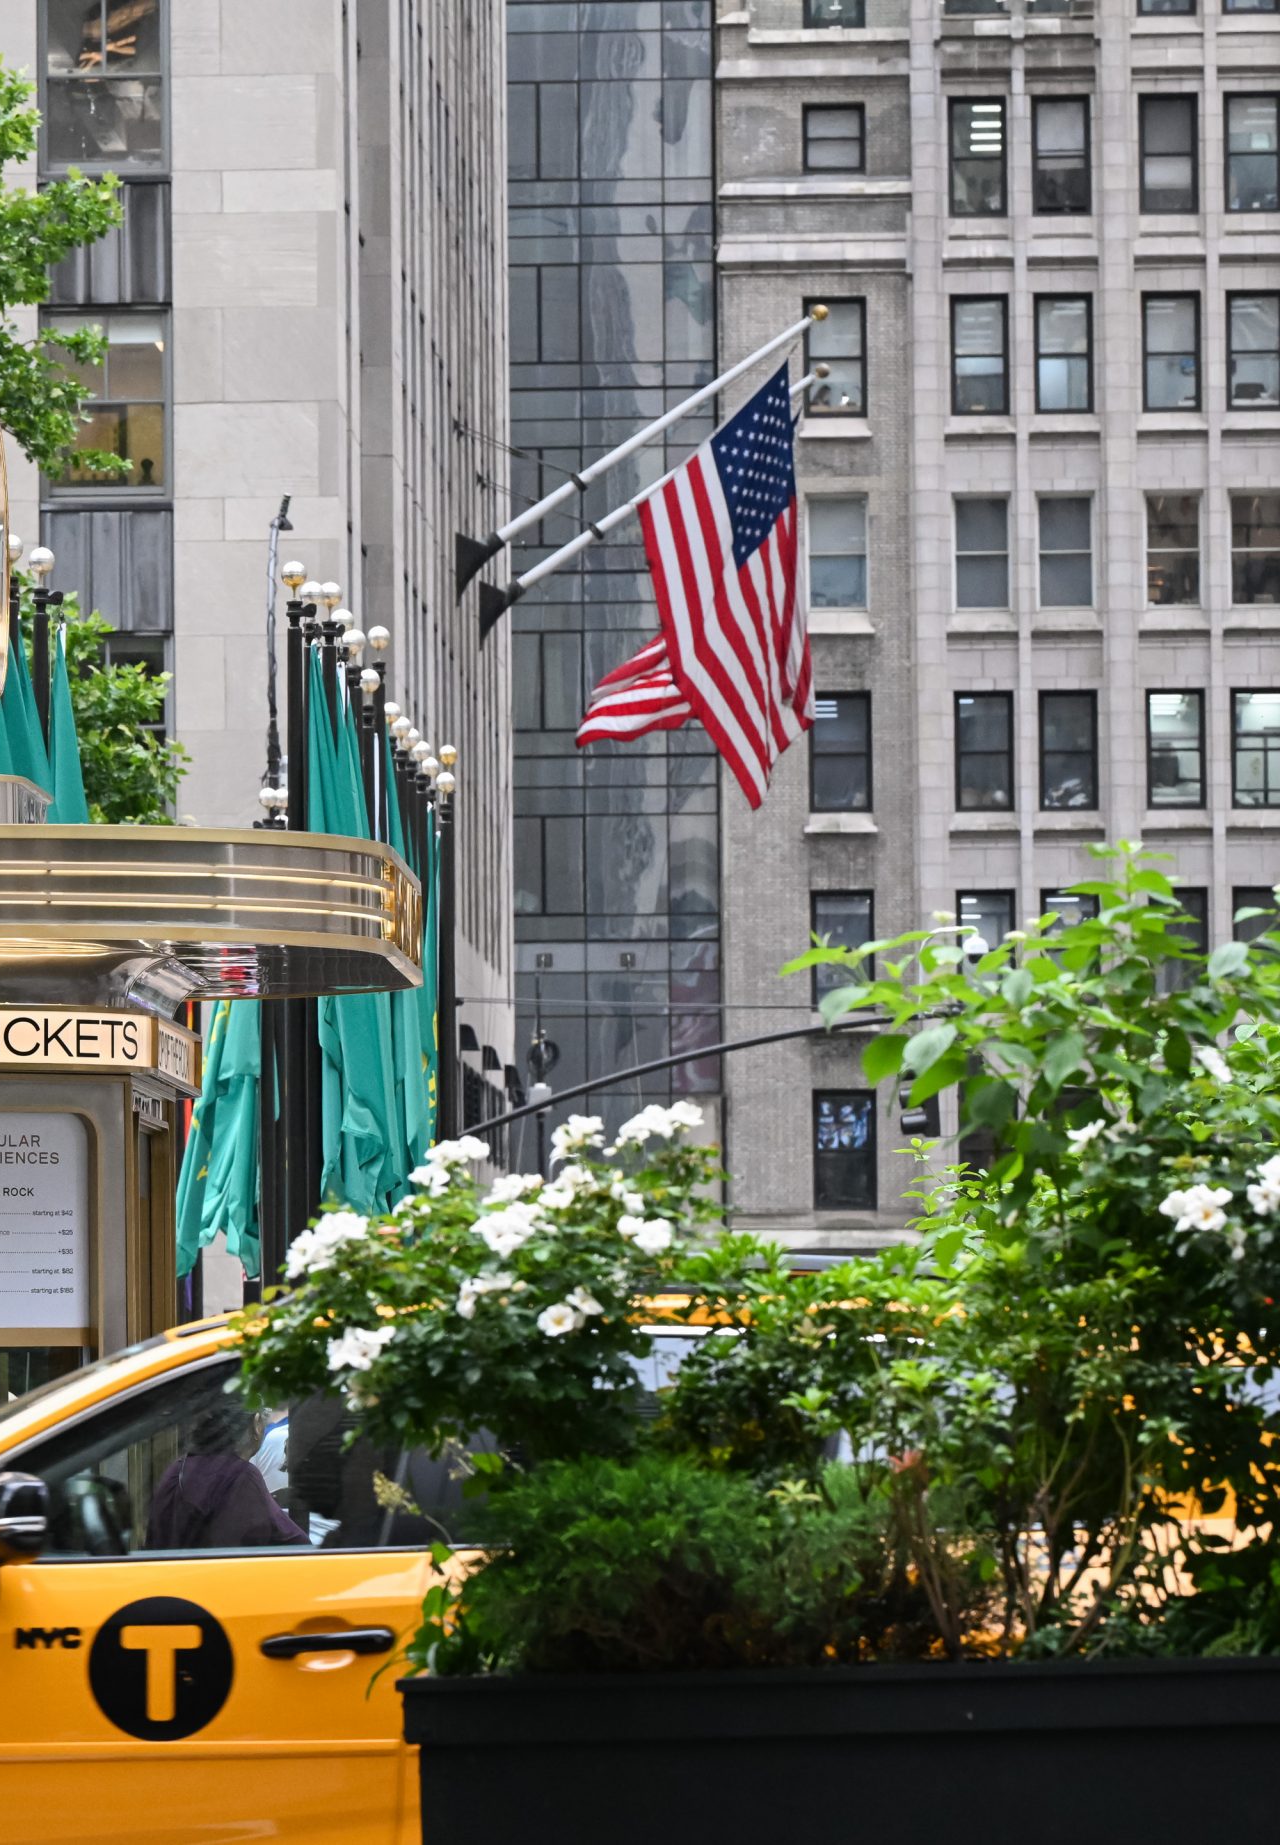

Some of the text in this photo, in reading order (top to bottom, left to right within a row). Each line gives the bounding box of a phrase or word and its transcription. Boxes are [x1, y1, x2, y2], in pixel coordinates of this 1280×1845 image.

[2, 1187, 35, 1197] ROCK
[14, 1625, 202, 1722] NYC T
